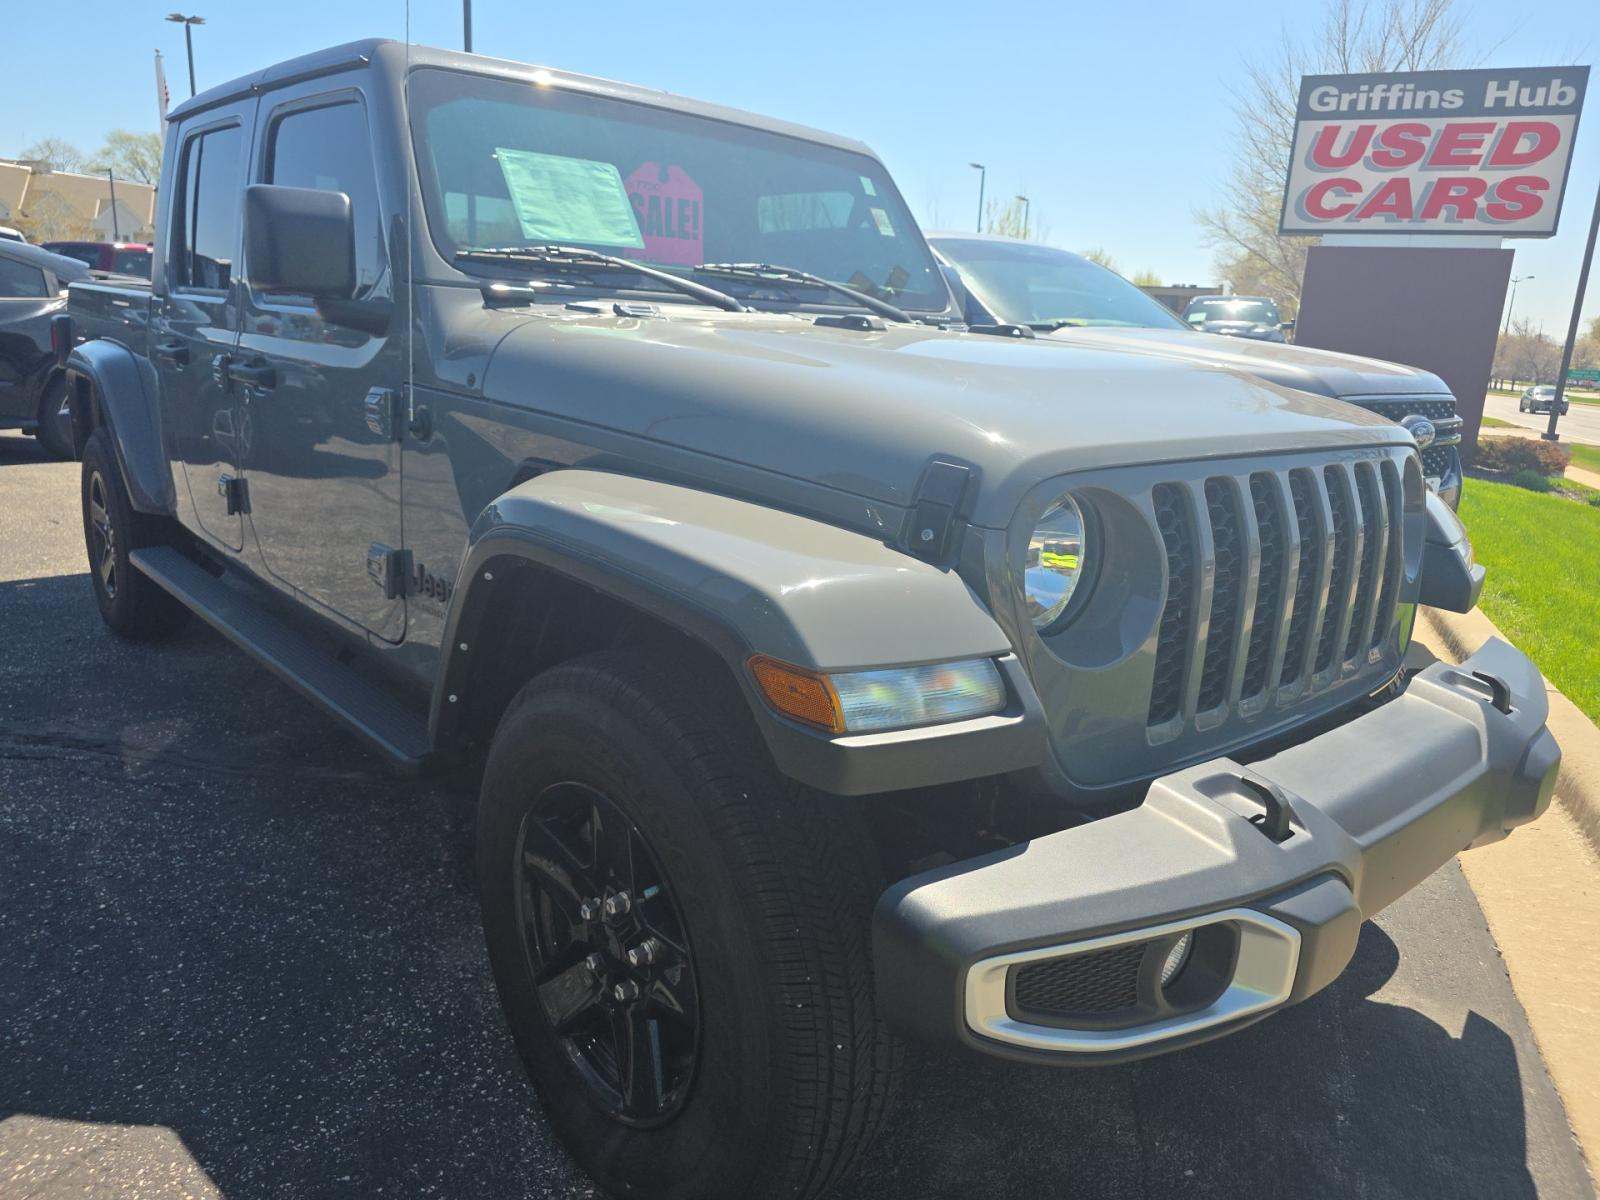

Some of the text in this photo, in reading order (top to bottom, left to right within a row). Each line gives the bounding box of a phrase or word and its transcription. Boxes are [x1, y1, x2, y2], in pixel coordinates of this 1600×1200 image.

[1308, 79, 1577, 112] Griffins Hub
[1306, 121, 1562, 172] USED
[629, 192, 699, 240] SALE!
[1296, 176, 1551, 224] CARS
